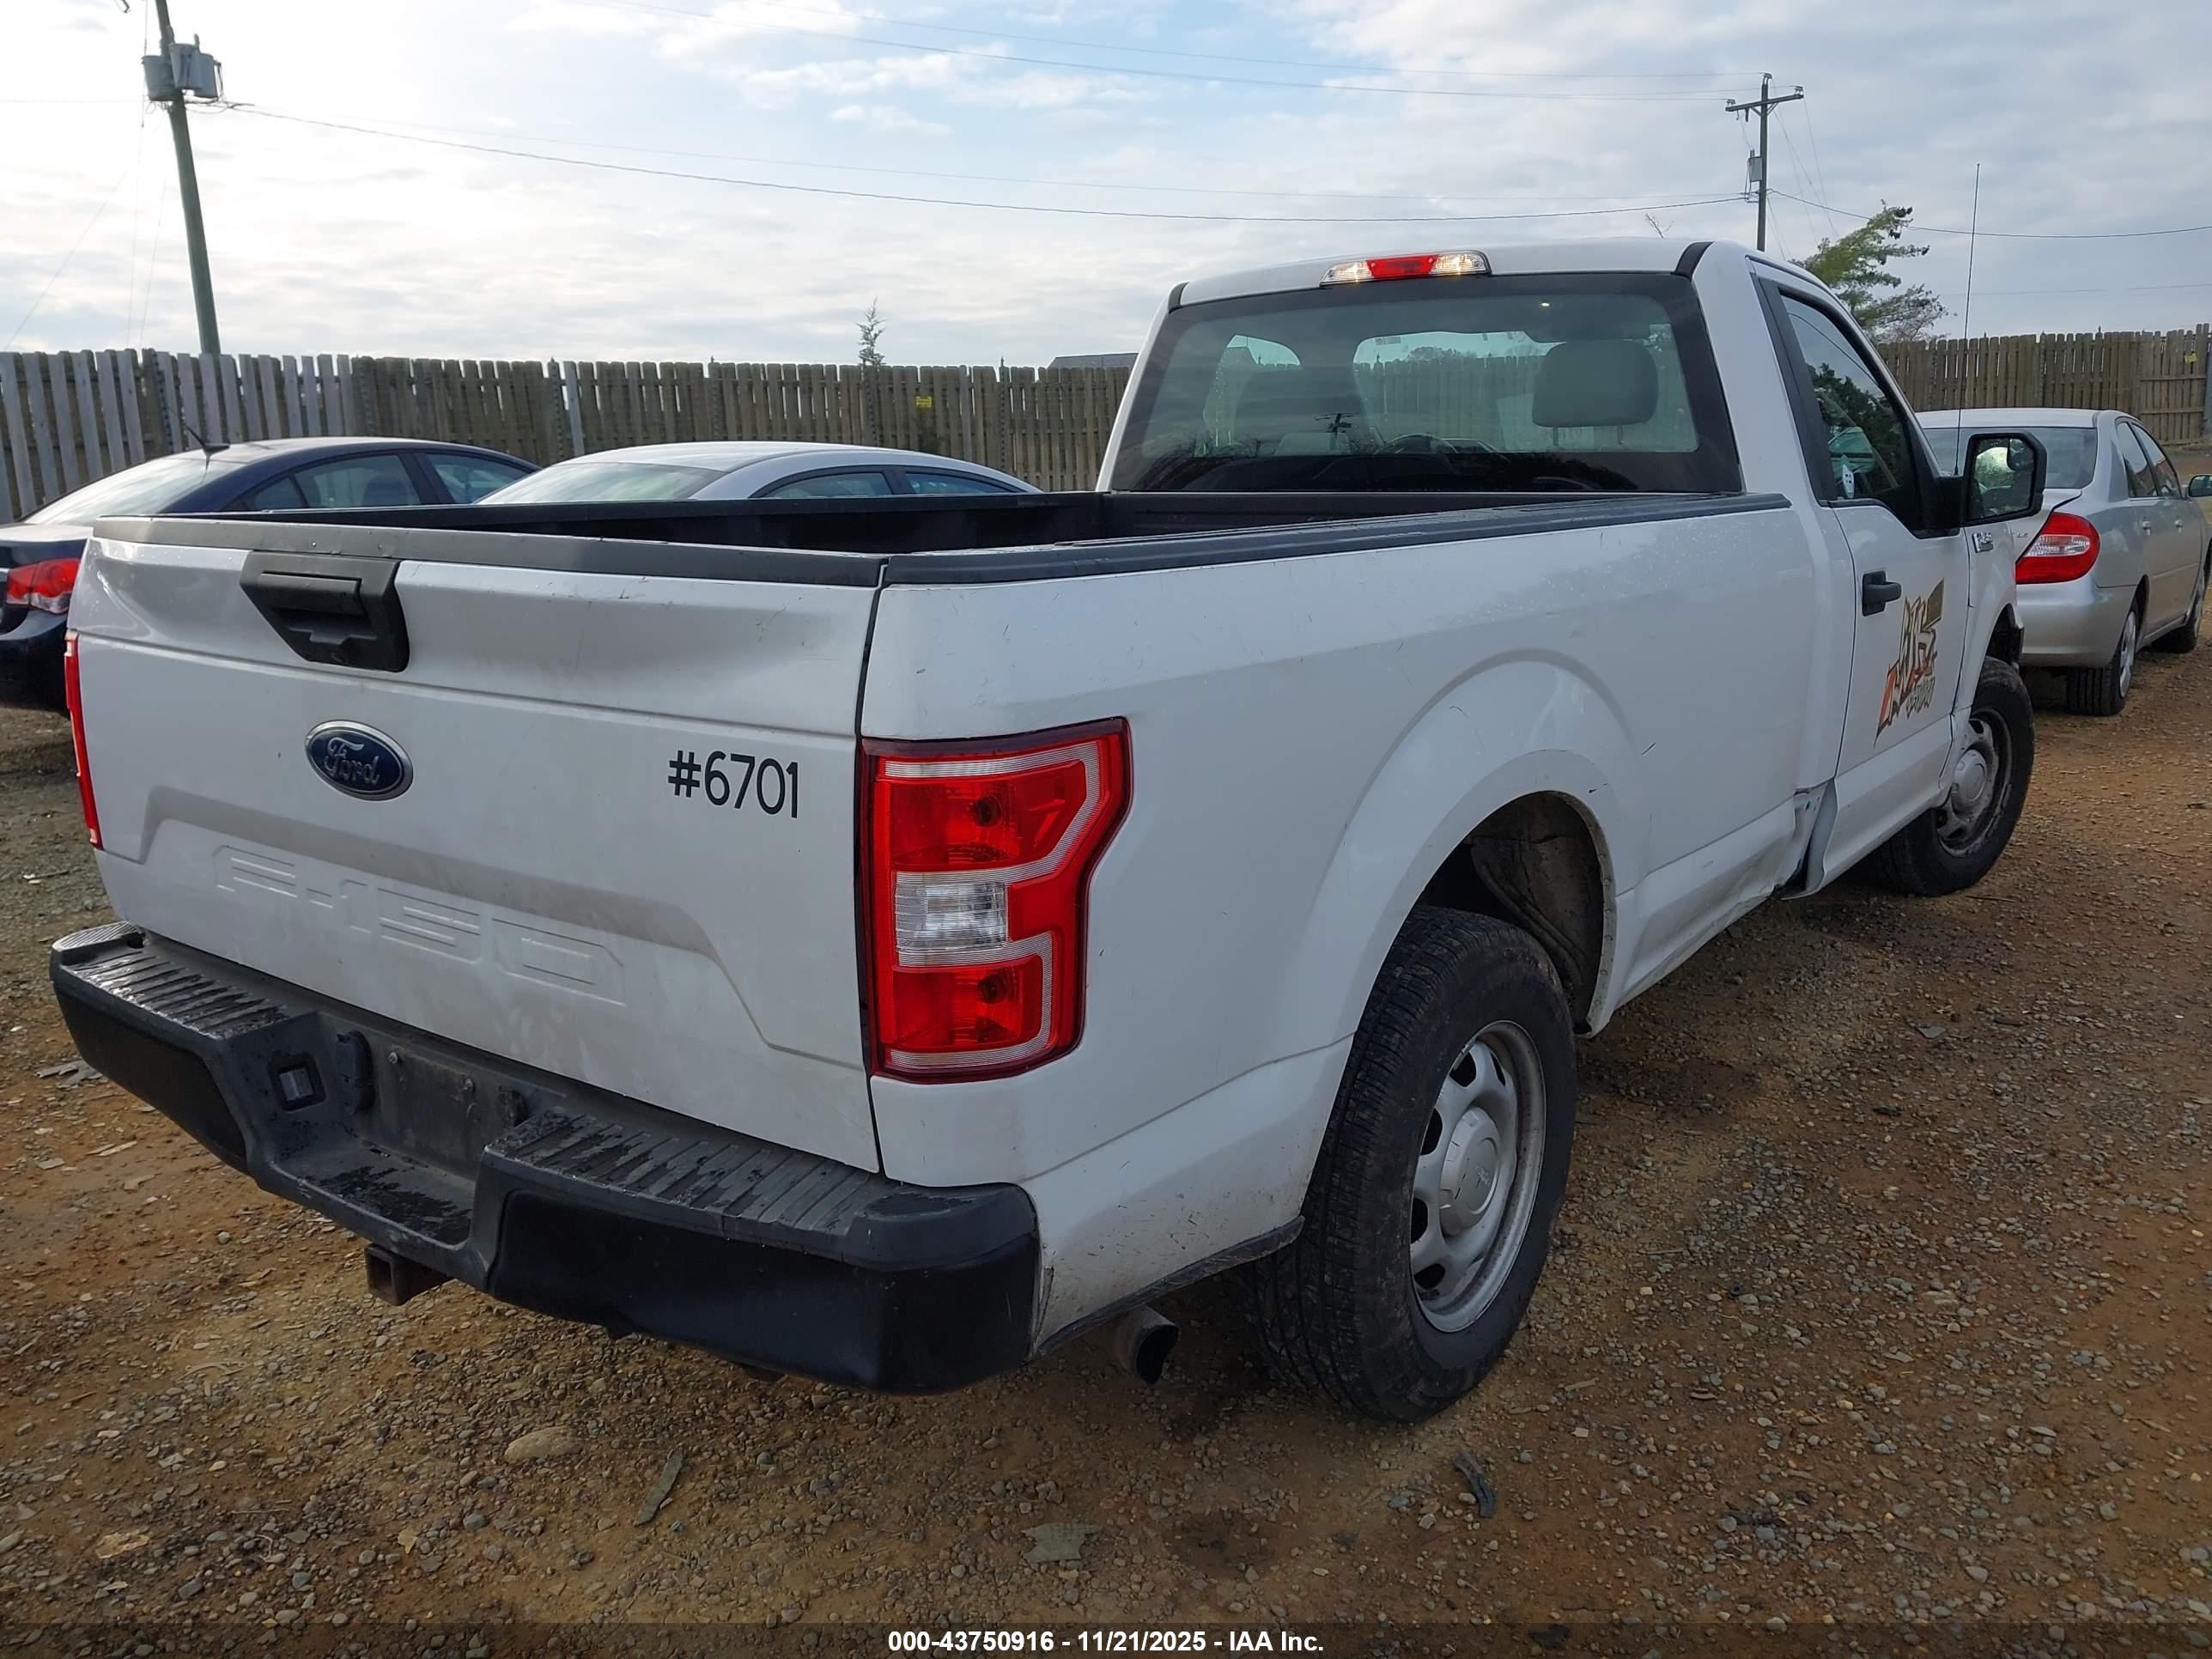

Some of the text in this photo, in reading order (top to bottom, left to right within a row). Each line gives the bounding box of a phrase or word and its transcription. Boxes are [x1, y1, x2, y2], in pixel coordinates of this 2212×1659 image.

[323, 737, 380, 785] Ford
[668, 750, 798, 818] #6701
[212, 845, 626, 1006] F-150
